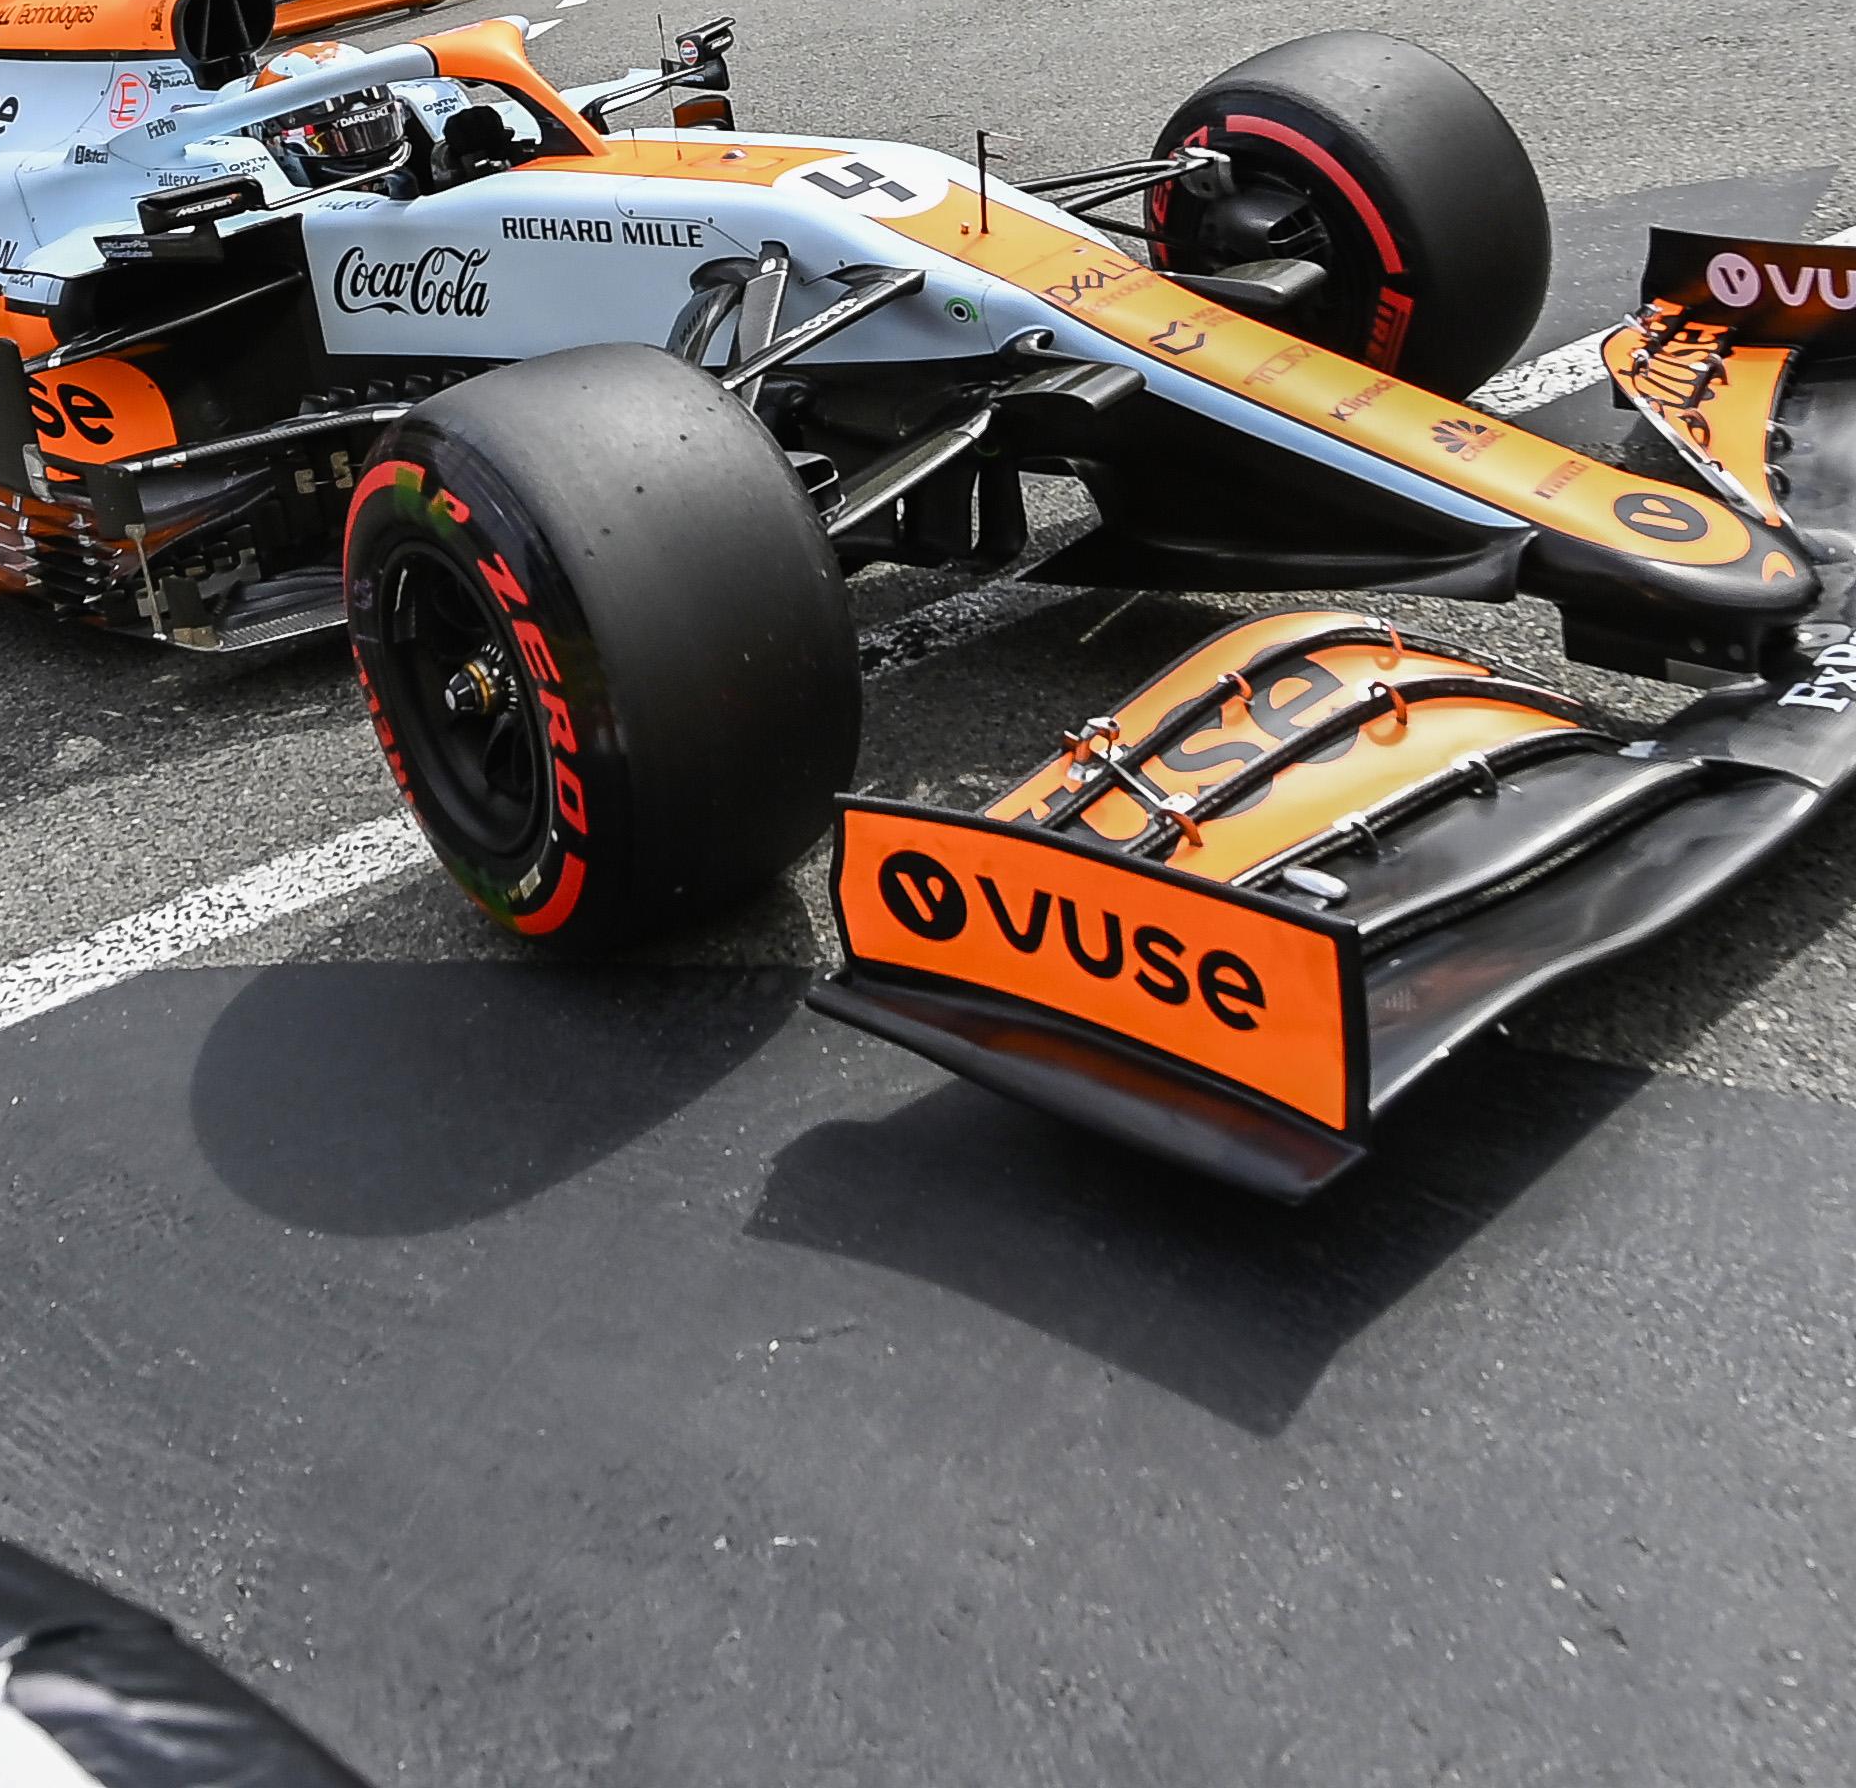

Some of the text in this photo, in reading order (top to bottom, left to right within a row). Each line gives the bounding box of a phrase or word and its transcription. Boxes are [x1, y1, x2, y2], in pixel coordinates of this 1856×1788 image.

[116, 82, 138, 122] E
[801, 160, 918, 204] 4
[501, 216, 705, 248] RICHARD MILLE
[333, 245, 492, 319] Coca-Cola
[1044, 259, 1143, 305] DELL
[475, 551, 590, 837] ZERO
[975, 874, 1270, 1032] vuse
